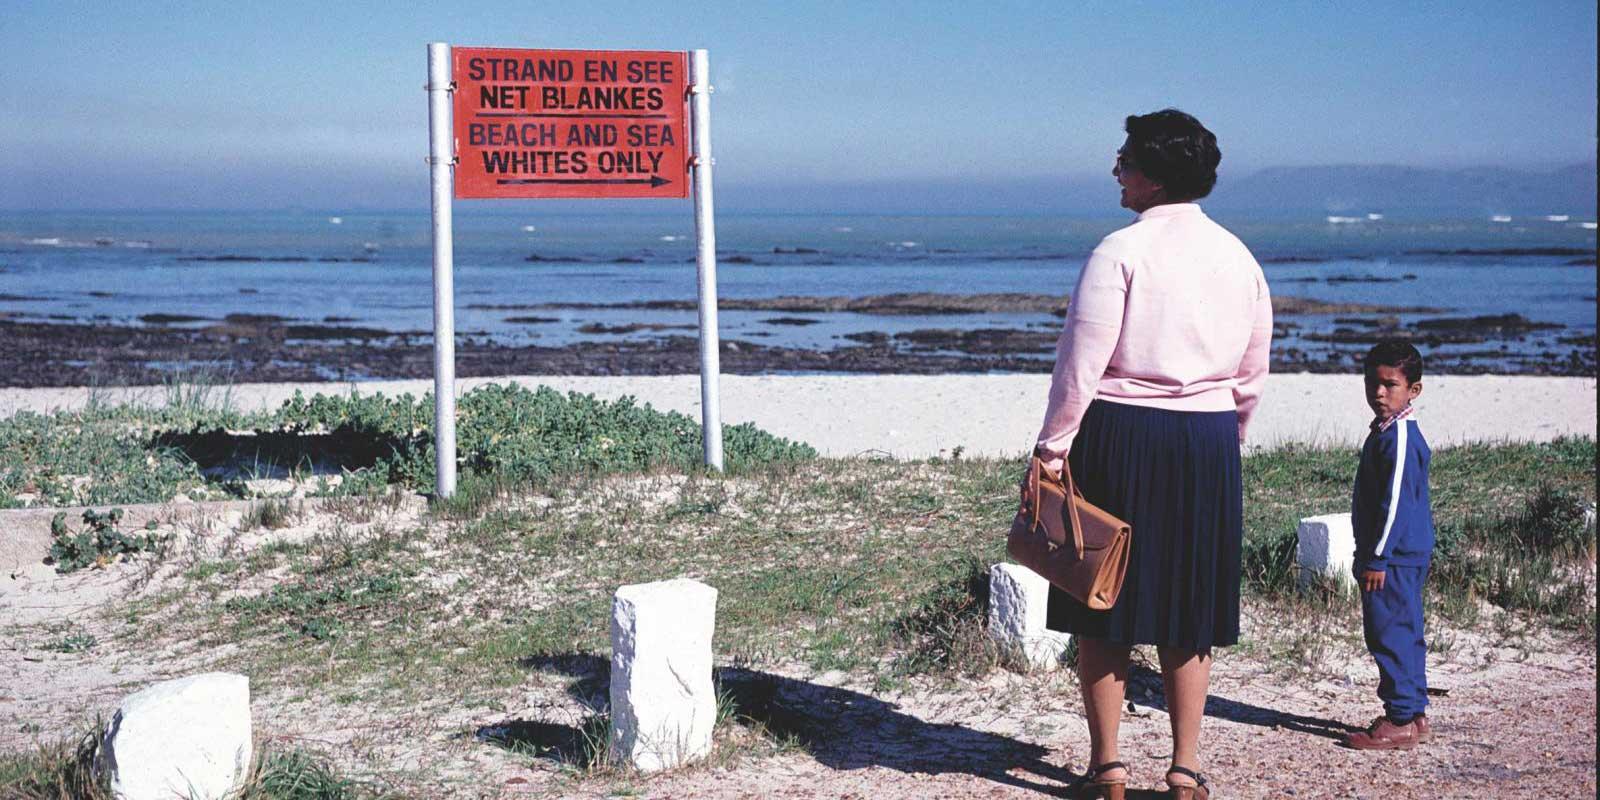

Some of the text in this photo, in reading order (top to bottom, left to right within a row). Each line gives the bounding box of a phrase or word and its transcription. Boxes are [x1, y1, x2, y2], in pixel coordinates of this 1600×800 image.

[469, 58, 673, 83] STRAND EN SEE
[480, 85, 664, 110] NET BLANKES
[469, 123, 675, 147] BEACH AND SEA
[482, 150, 664, 174] WHITES ONLY
